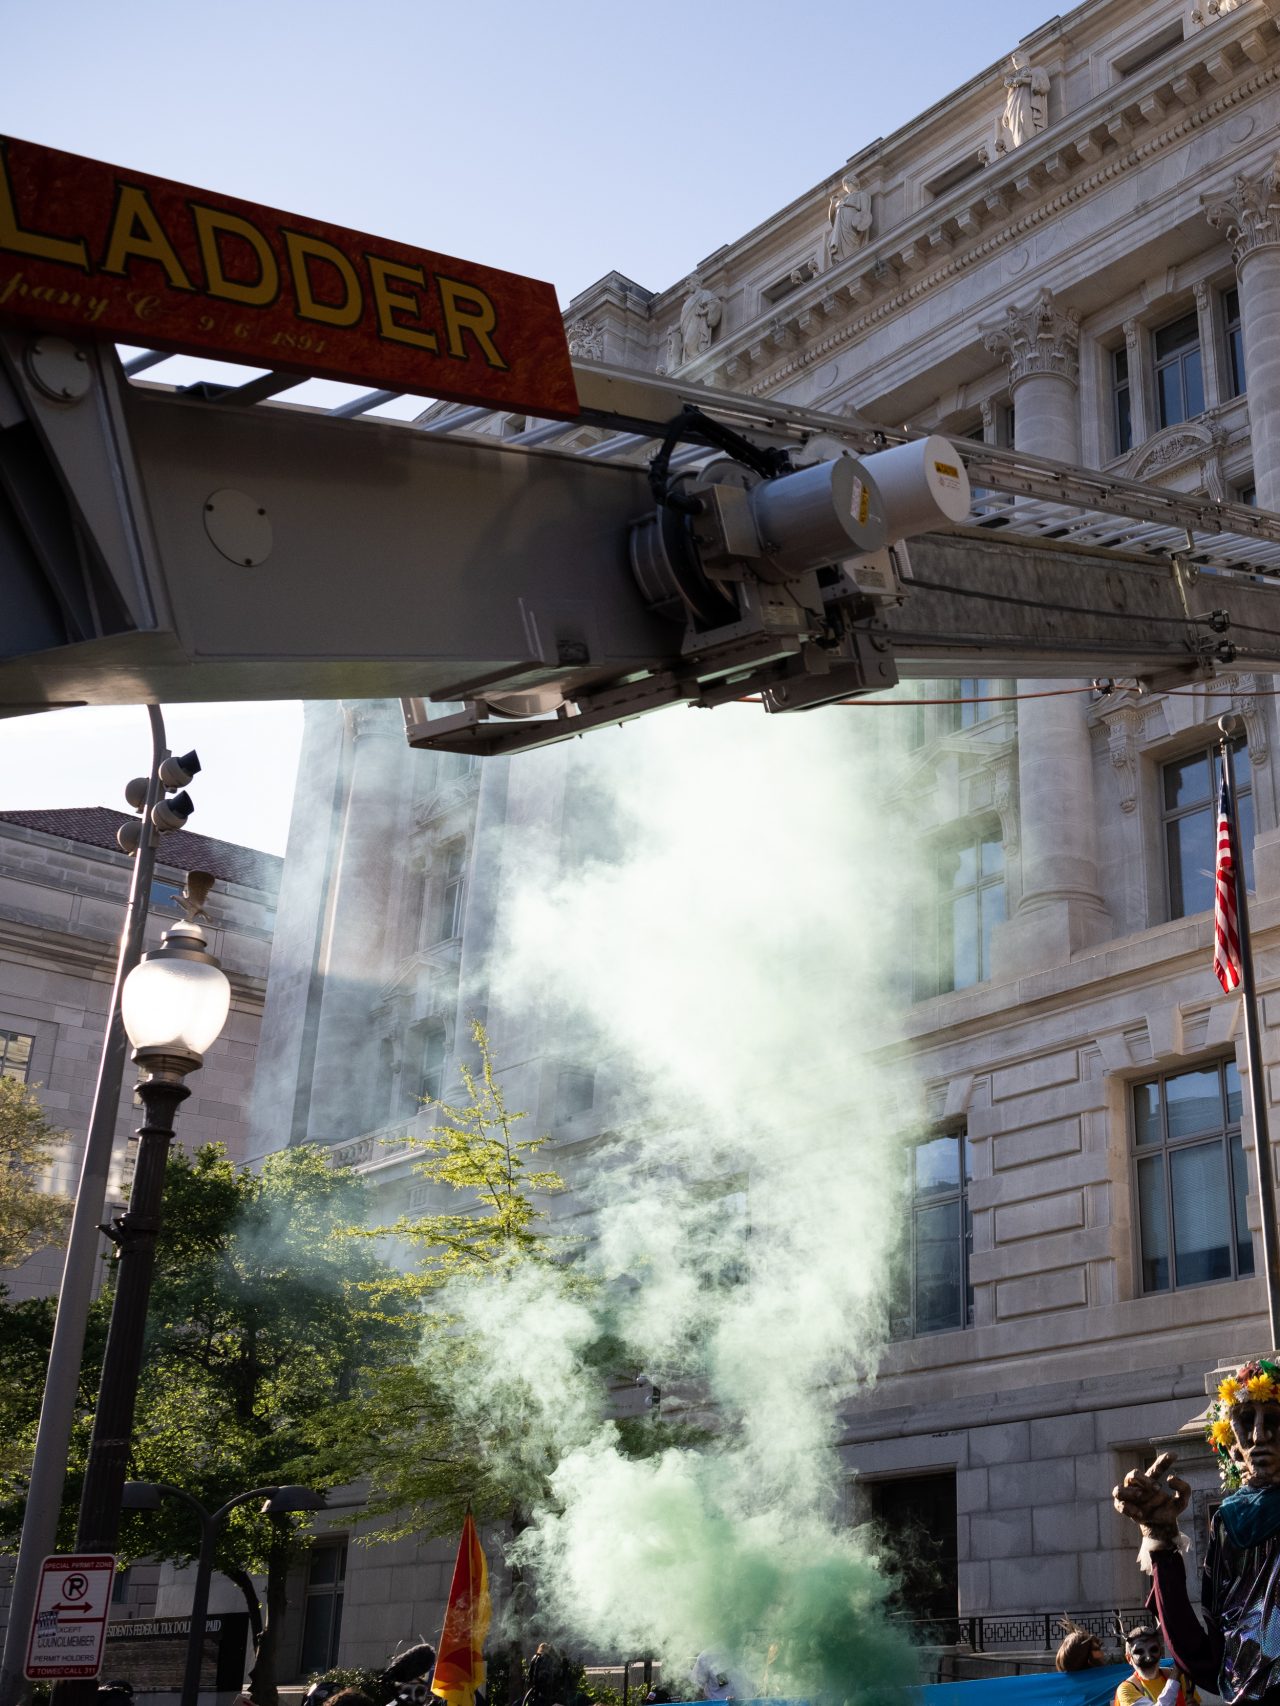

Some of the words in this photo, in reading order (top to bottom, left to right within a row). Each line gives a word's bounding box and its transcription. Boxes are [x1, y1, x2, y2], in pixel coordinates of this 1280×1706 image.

[0, 140, 508, 370] LADDER
[44, 1562, 70, 1570] SPECIAL
[71, 1561, 95, 1569] PERMIT
[95, 1560, 113, 1568] ZONE
[57, 1626, 81, 1634] XCEPT
[133, 1623, 160, 1636] FEDERAL
[160, 1621, 174, 1634] TAX
[205, 1619, 222, 1633] PAID
[33, 1655, 60, 1663] PERMIT
[61, 1654, 95, 1662] HOLDERS
[28, 1668, 35, 1676] IF
[63, 1667, 83, 1675] CALL
